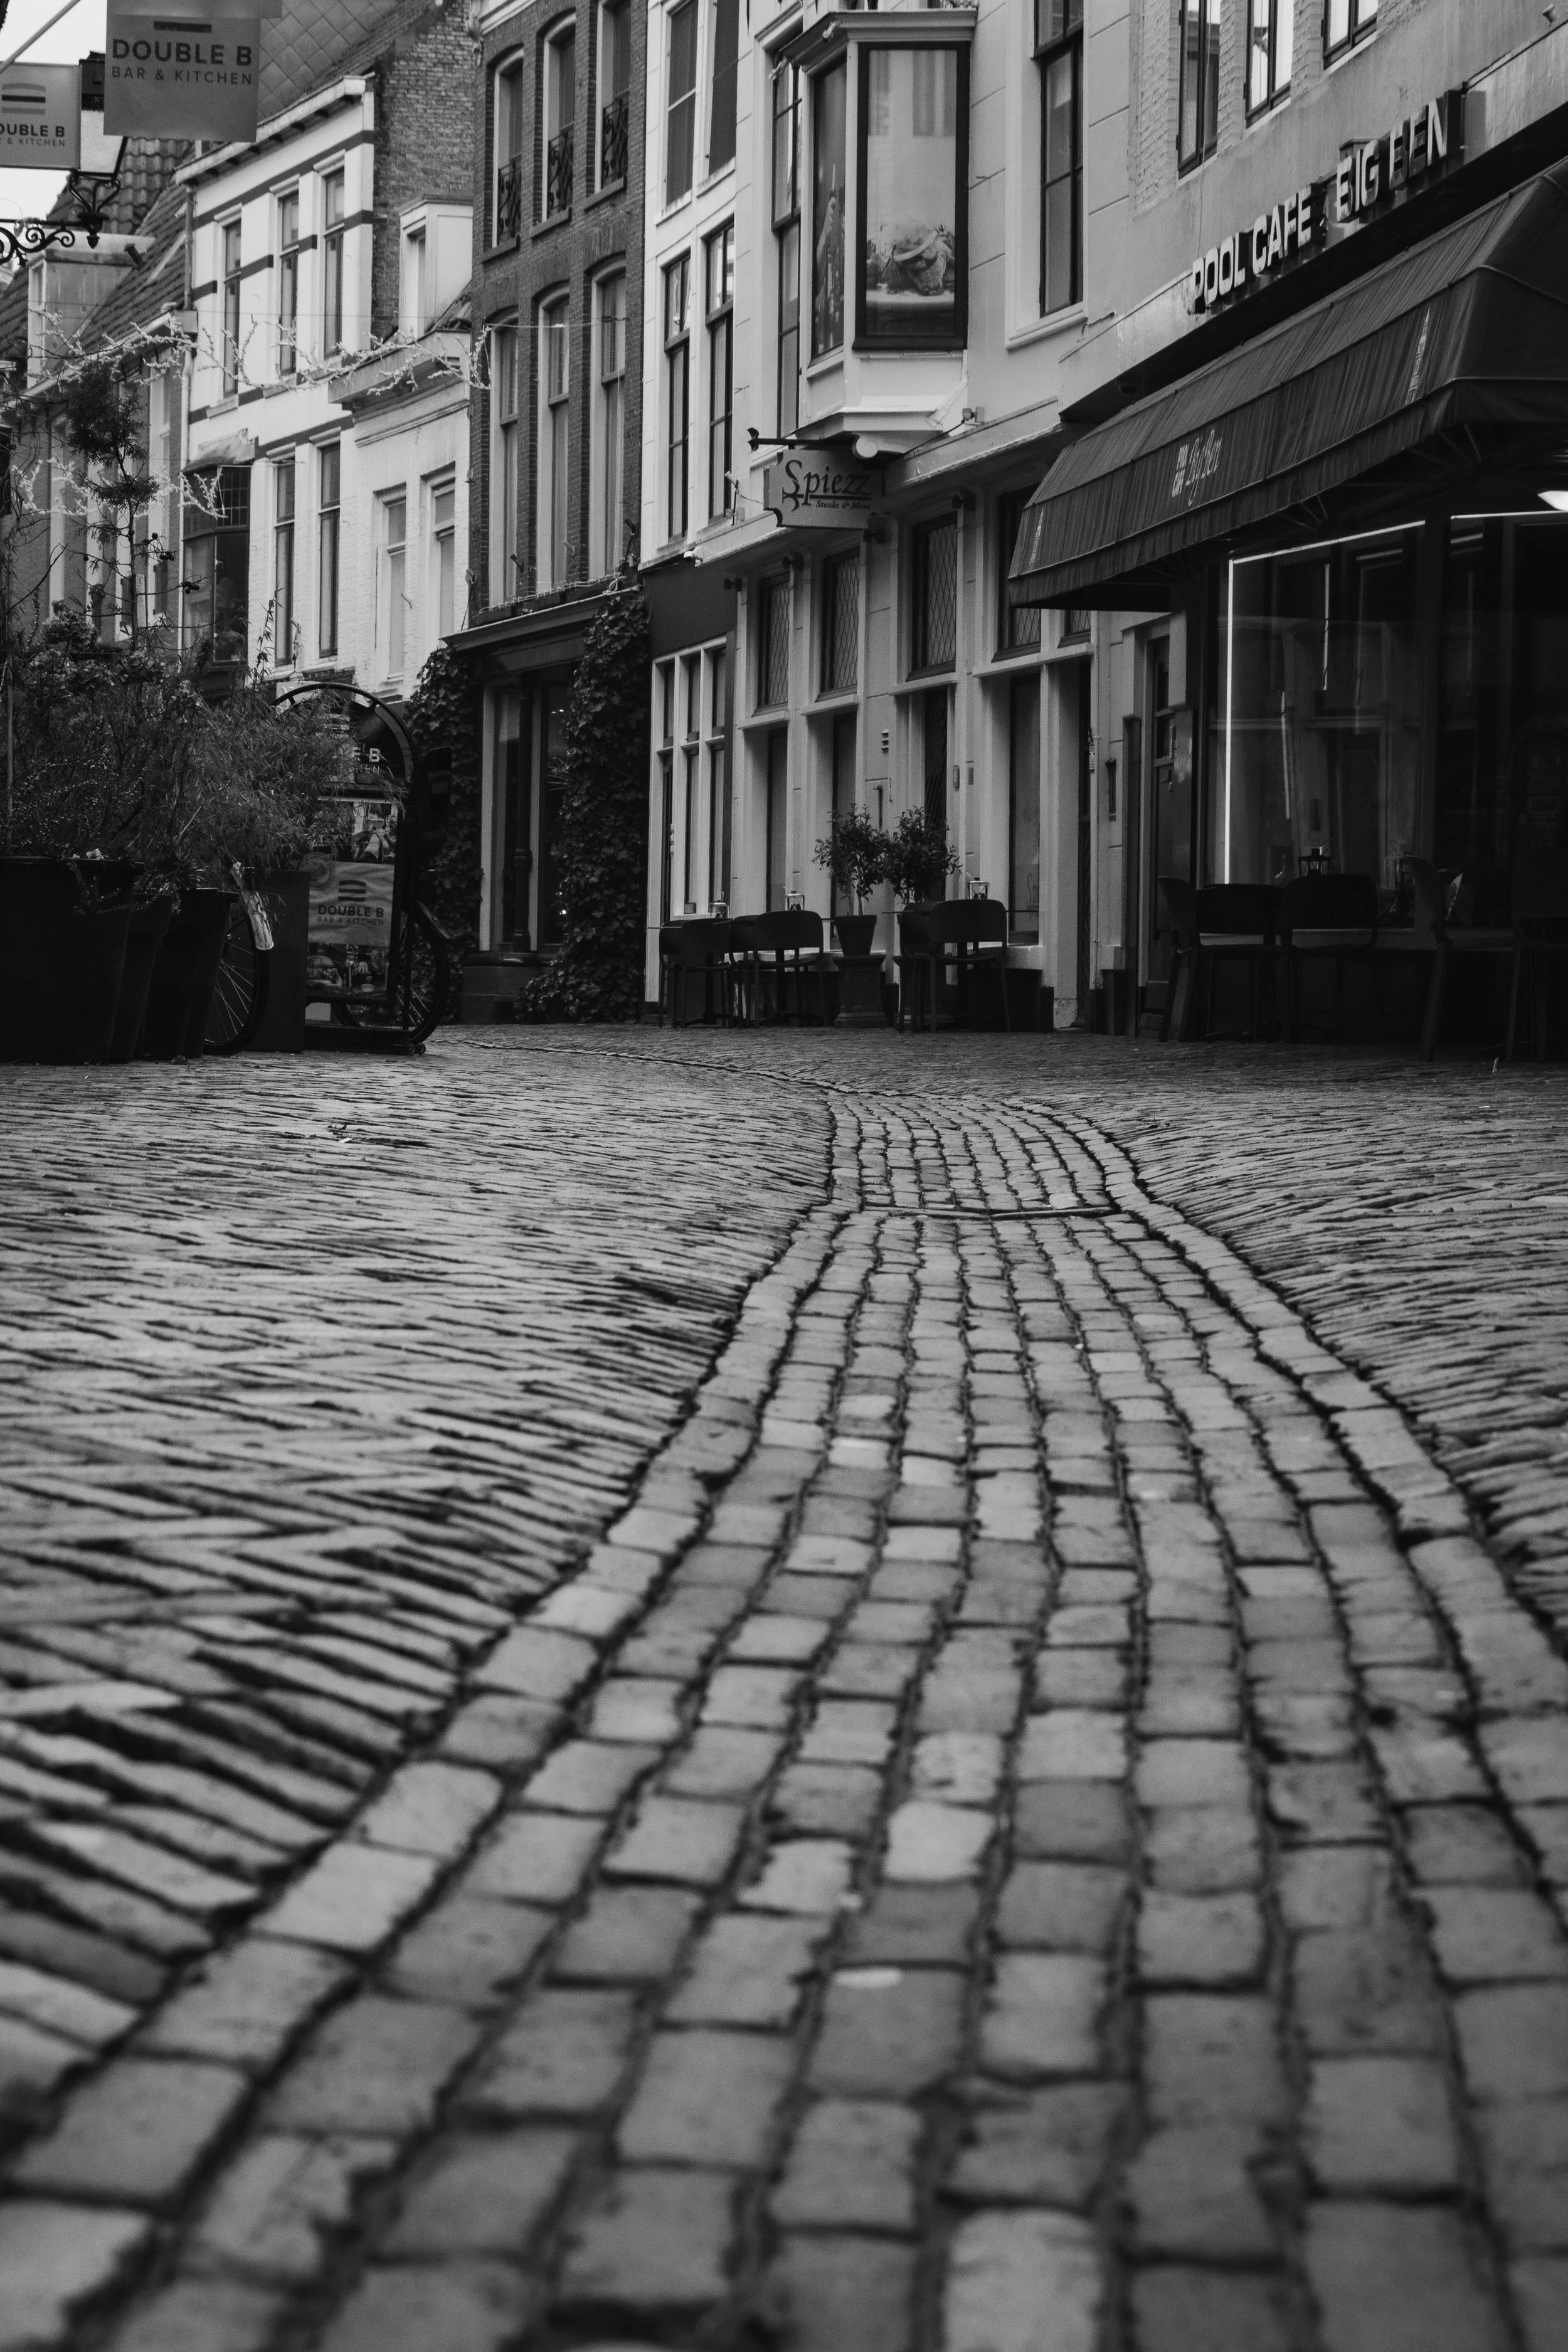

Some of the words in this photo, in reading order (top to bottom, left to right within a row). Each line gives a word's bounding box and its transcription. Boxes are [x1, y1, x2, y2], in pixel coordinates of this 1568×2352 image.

[112, 38, 224, 64] DOUBLE
[236, 46, 252, 66] B
[112, 66, 146, 80] BAR
[156, 68, 164, 80] &
[175, 70, 251, 85] KITCHEN
[55, 125, 65, 137] B
[19, 138, 65, 147] KITCHEN
[1337, 139, 1379, 221] BIG
[1389, 92, 1448, 190] BEN
[1192, 232, 1246, 314] POOL
[1253, 186, 1311, 275] CAFE
[783, 460, 872, 511] Spiezz
[816, 500, 839, 509] Steaks
[850, 502, 871, 510] More
[369, 748, 381, 762] B
[318, 905, 371, 917] DOUBLE
[376, 908, 384, 918] B
